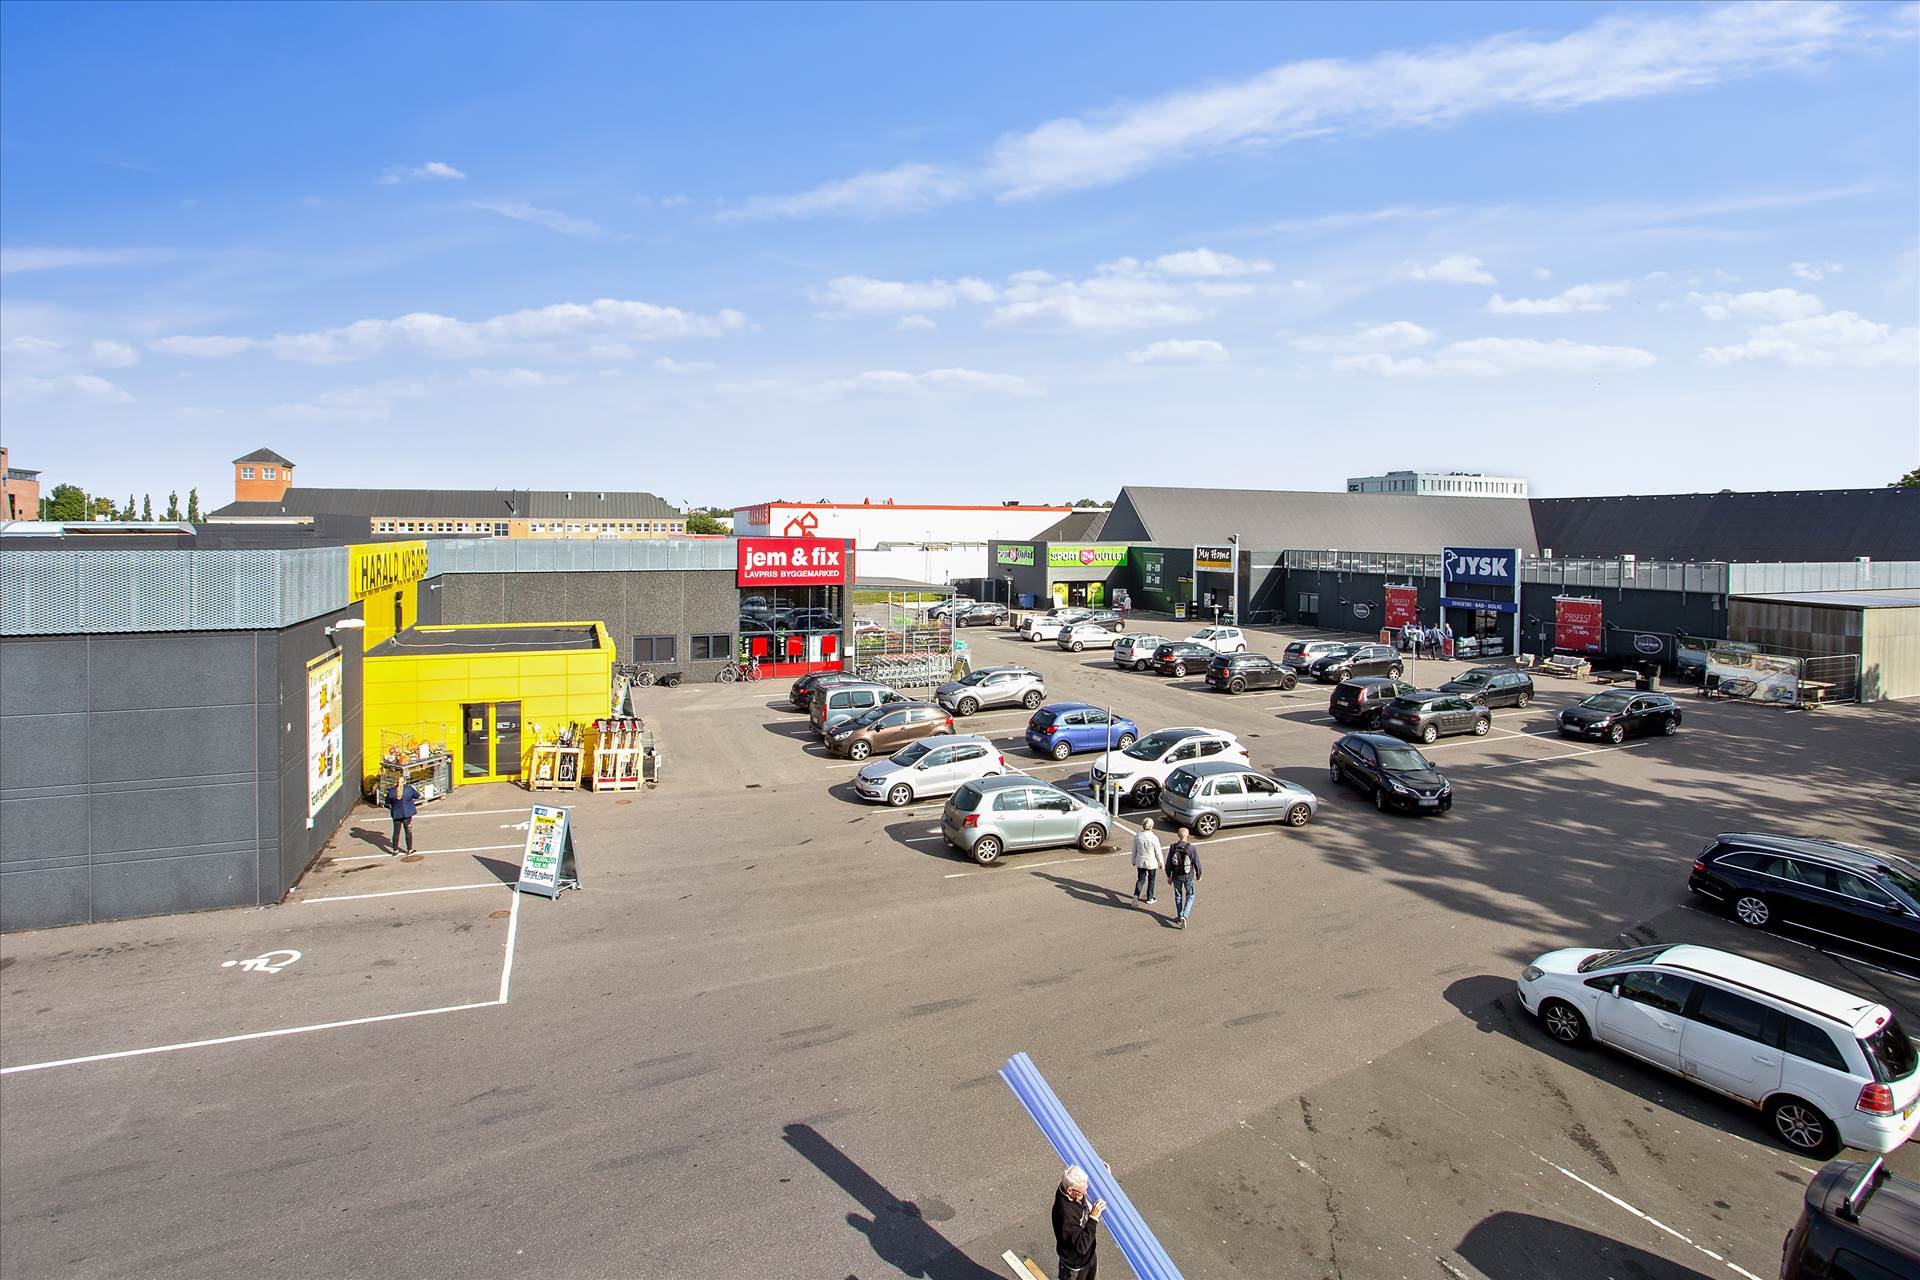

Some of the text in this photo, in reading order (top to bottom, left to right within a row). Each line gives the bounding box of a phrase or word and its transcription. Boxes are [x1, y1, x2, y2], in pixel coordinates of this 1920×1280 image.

[745, 547, 839, 570] jem & fix
[1050, 551, 1126, 561] SPORT 24 OUTLET
[1198, 549, 1230, 560] My Home
[361, 548, 428, 592] HARALD NYBORG
[744, 570, 840, 578] LAVPRIS BYGGEMARKED
[1455, 556, 1508, 577] JYSK
